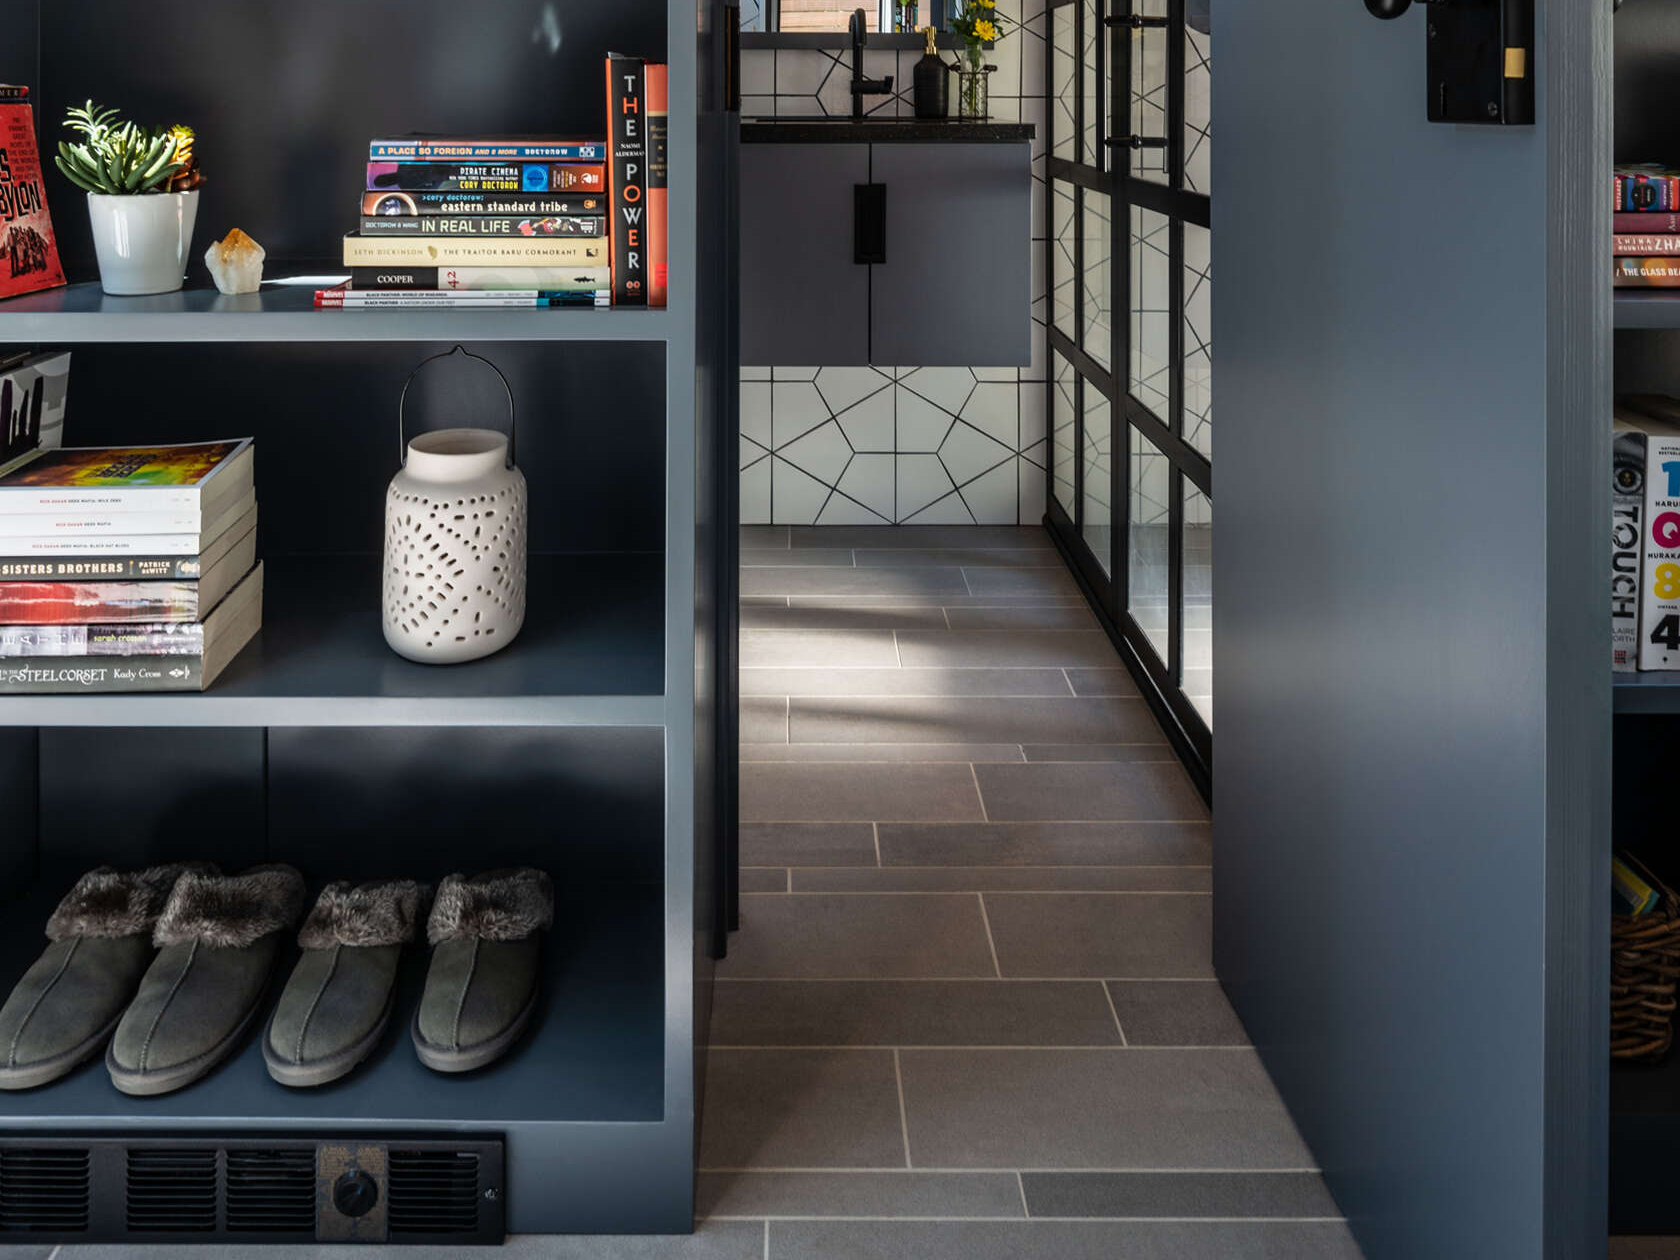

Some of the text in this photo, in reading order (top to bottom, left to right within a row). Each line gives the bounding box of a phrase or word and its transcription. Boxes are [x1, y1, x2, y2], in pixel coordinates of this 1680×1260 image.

[623, 75, 638, 137] THE
[378, 147, 386, 155] A
[387, 147, 416, 155] PLACE
[418, 147, 431, 155] SO
[433, 147, 473, 155] FOREIGN
[497, 147, 518, 155] MORE
[460, 167, 519, 176] PIRATE CINEMA
[459, 181, 480, 190] CORY
[441, 202, 568, 212] eastern standard tribe
[622, 163, 642, 269] POWER
[421, 220, 510, 233] IN REAL LIFE
[354, 248, 424, 256] SETH DICKINSON
[443, 248, 577, 256] THE TRAITOR BARU CORMORANT
[1623, 267, 1666, 277] THE GLASS
[376, 275, 414, 284] COOPER
[2, 563, 123, 574] SISTERS BROTHERS
[1613, 506, 1639, 620] TOUCH
[1653, 563, 1680, 600] 8
[1650, 614, 1680, 651] 4
[59, 669, 108, 685] CORSET
[114, 669, 137, 681] Kady
